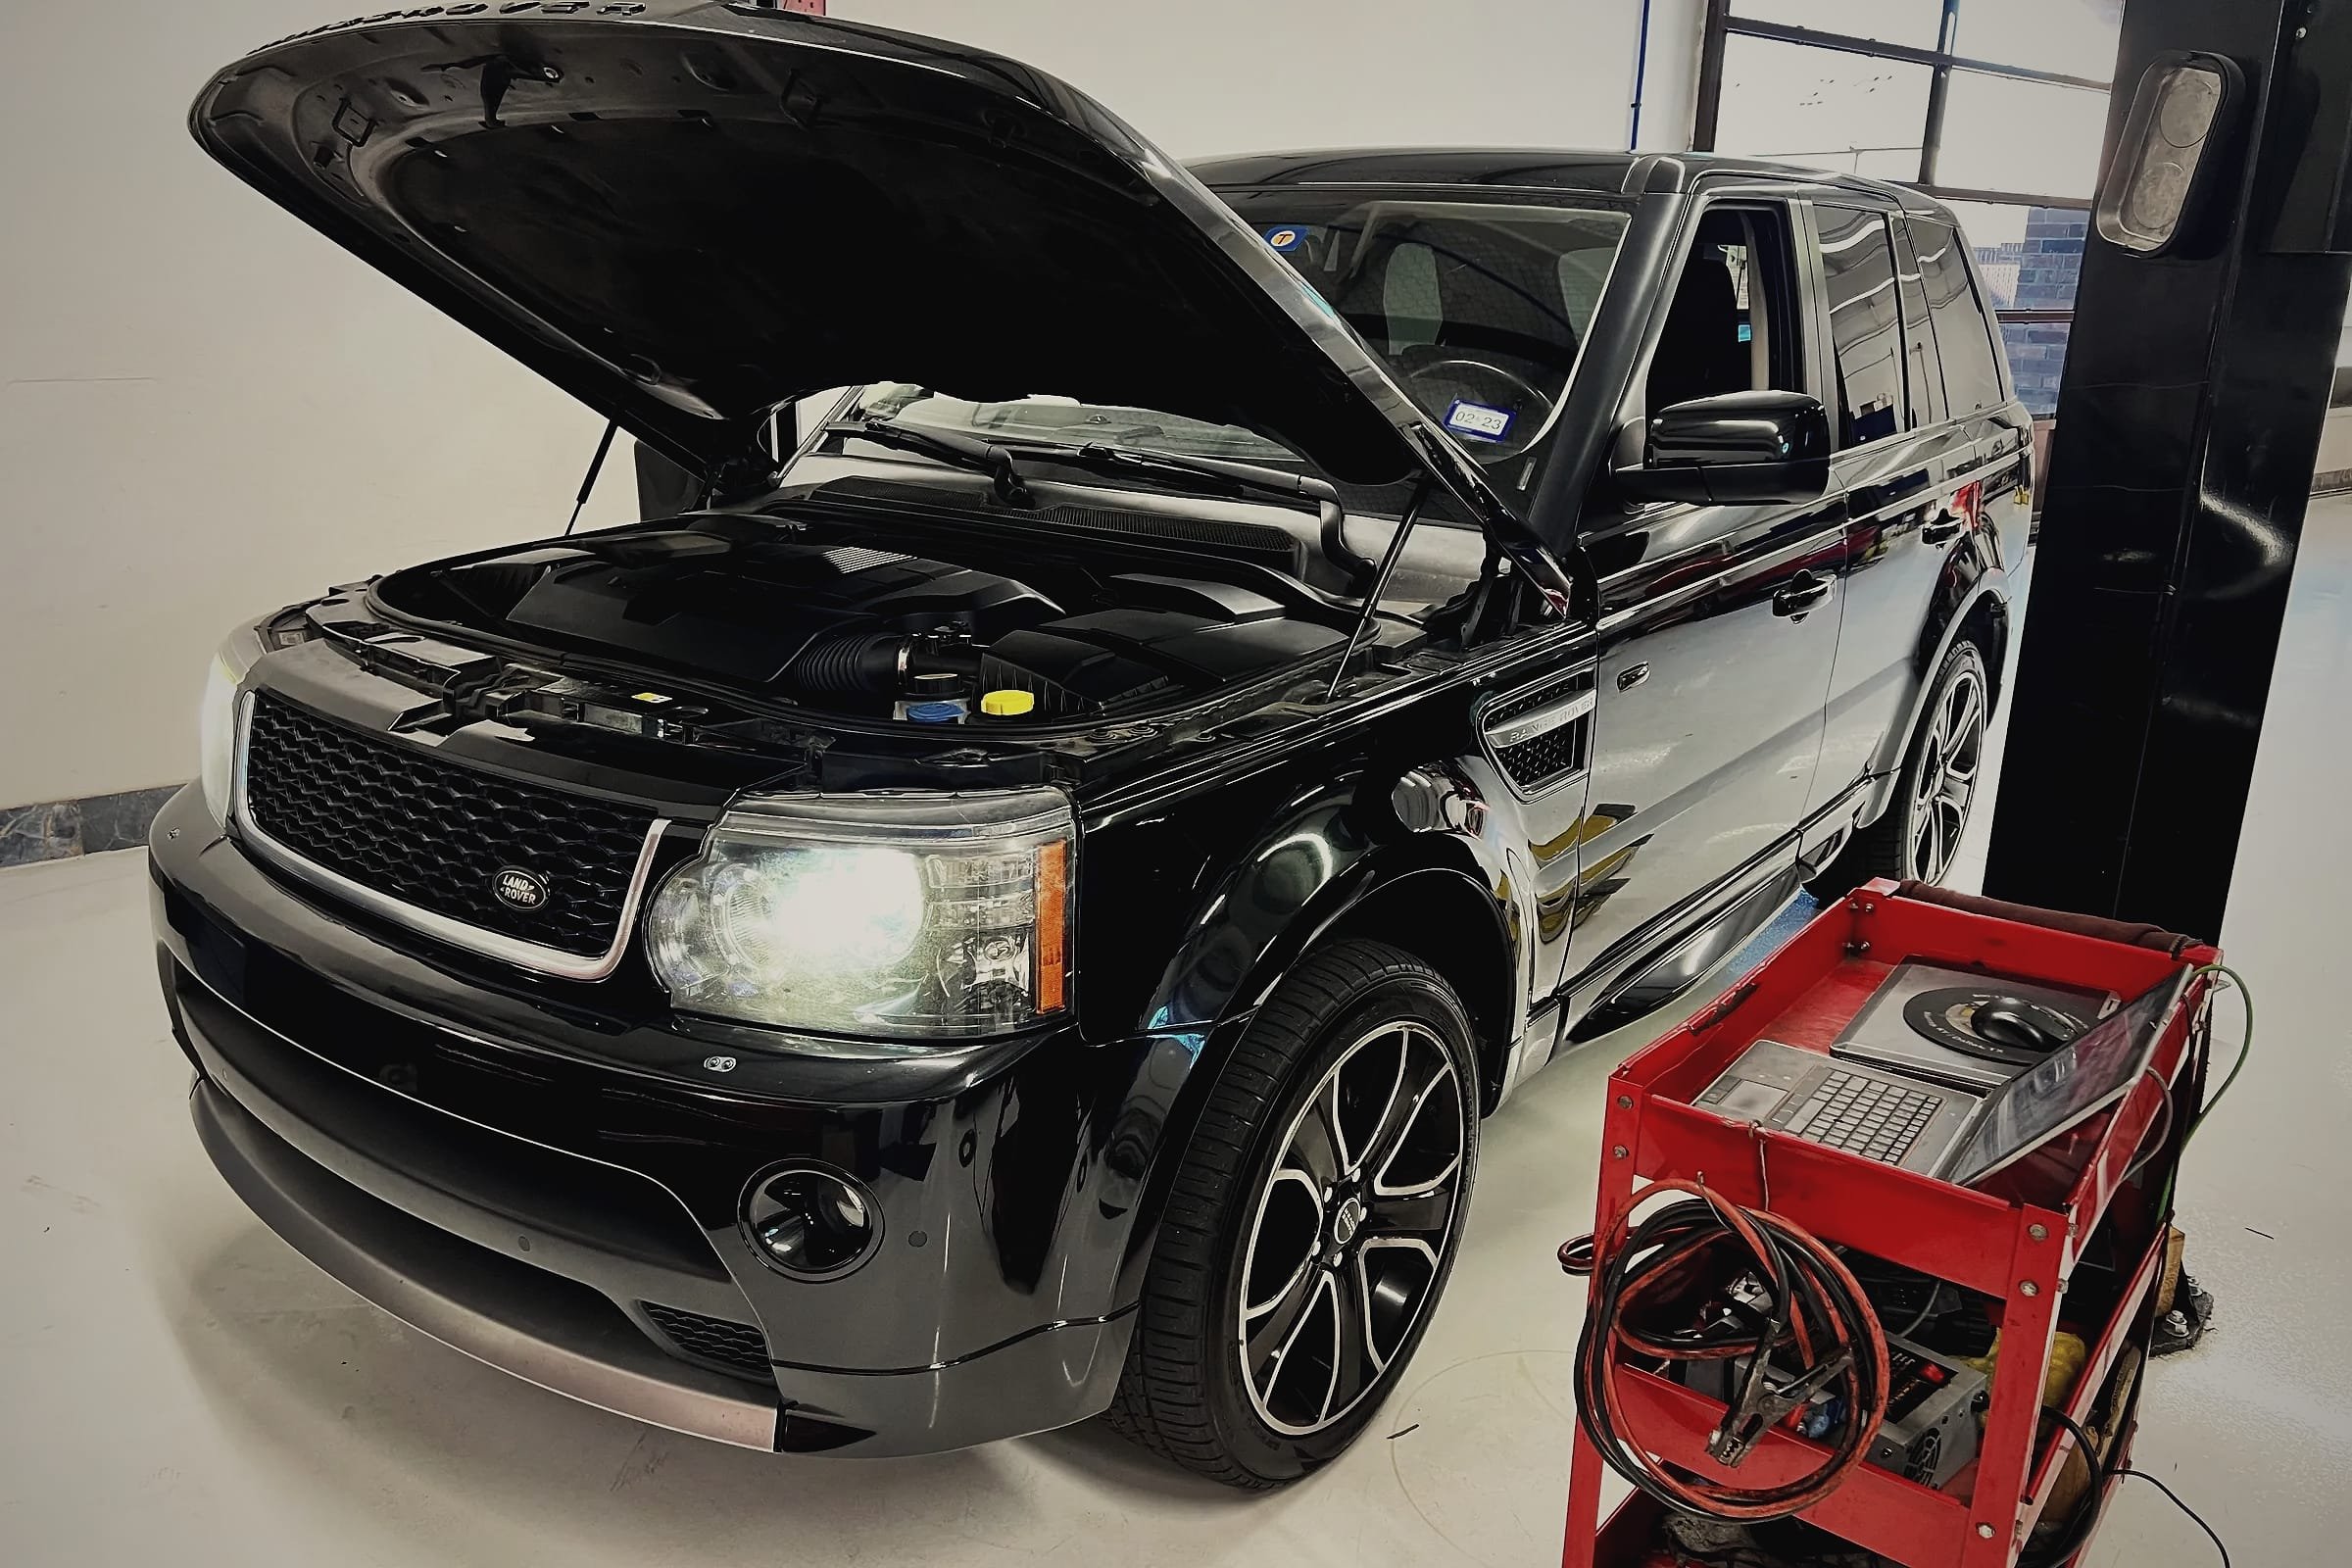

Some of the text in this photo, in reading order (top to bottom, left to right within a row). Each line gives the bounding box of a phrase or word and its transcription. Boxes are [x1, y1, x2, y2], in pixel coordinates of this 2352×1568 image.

[1277, 233, 1293, 245] T
[1455, 411, 1501, 430] 02 23
[502, 874, 529, 891] LAND
[504, 887, 537, 905] ROVER
